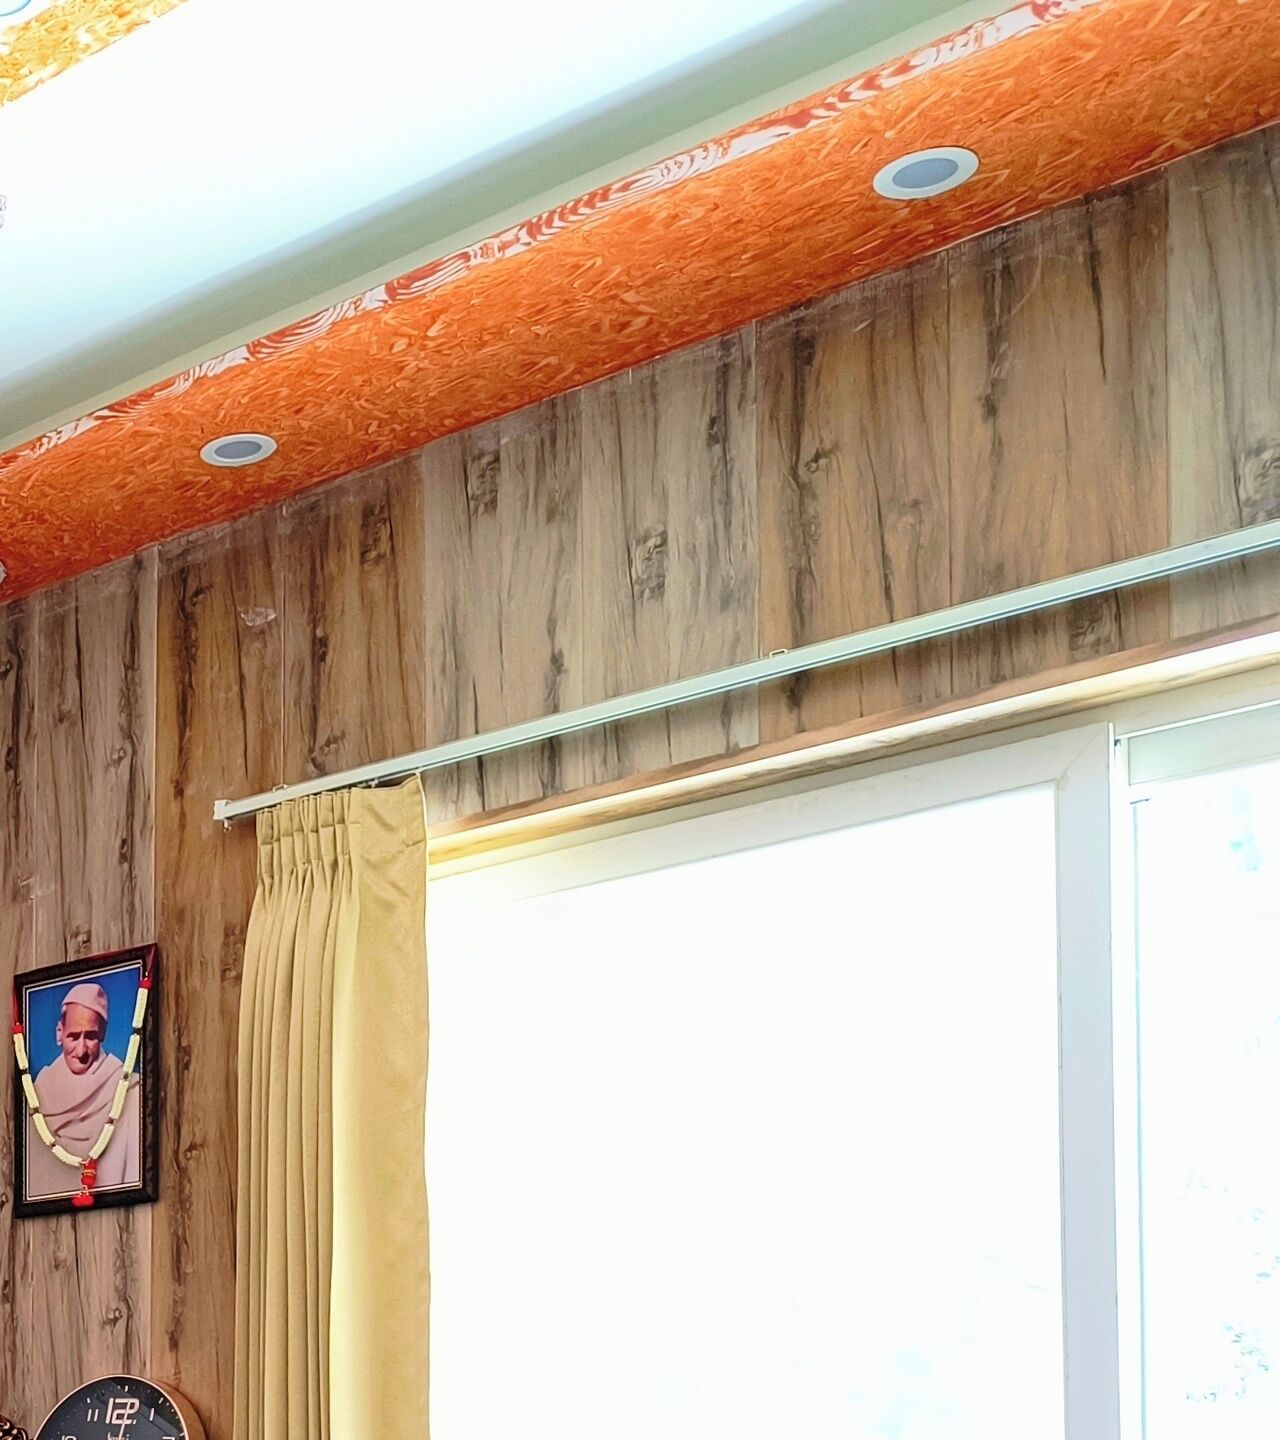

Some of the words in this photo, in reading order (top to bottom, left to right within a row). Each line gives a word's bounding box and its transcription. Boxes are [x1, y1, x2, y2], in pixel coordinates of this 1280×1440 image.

[87, 1408, 99, 1422] 11
[105, 1397, 140, 1425] 12
[149, 1407, 155, 1421] 1
